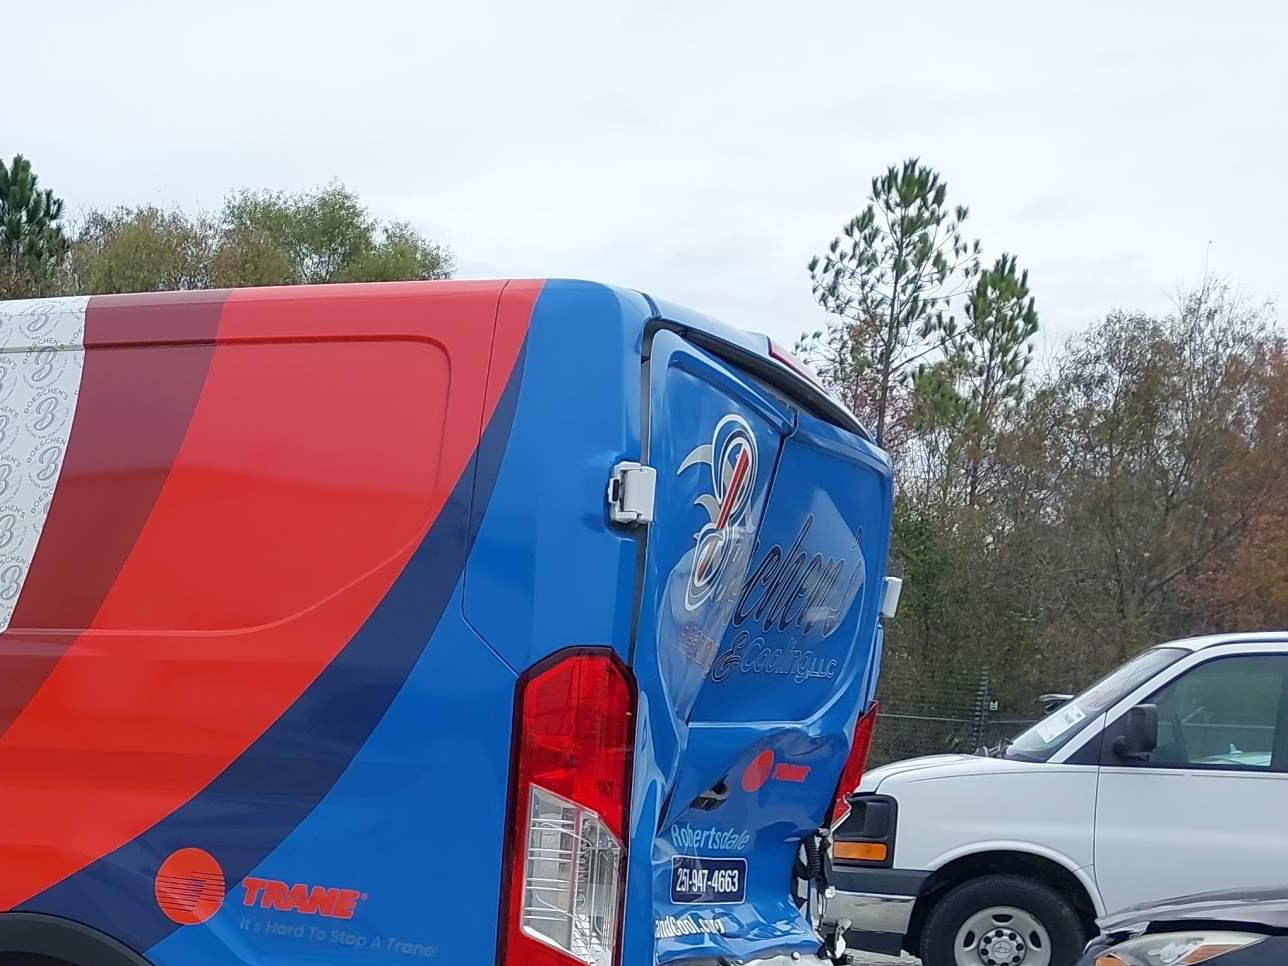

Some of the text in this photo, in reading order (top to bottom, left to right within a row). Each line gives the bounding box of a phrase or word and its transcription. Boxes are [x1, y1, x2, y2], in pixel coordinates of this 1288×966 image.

[671, 823, 751, 851] Robertsdale
[676, 867, 739, 893] 251-947-4663
[242, 876, 361, 920] TRANE
[266, 921, 304, 938] Hard
[309, 926, 327, 940] To
[370, 936, 381, 949] A
